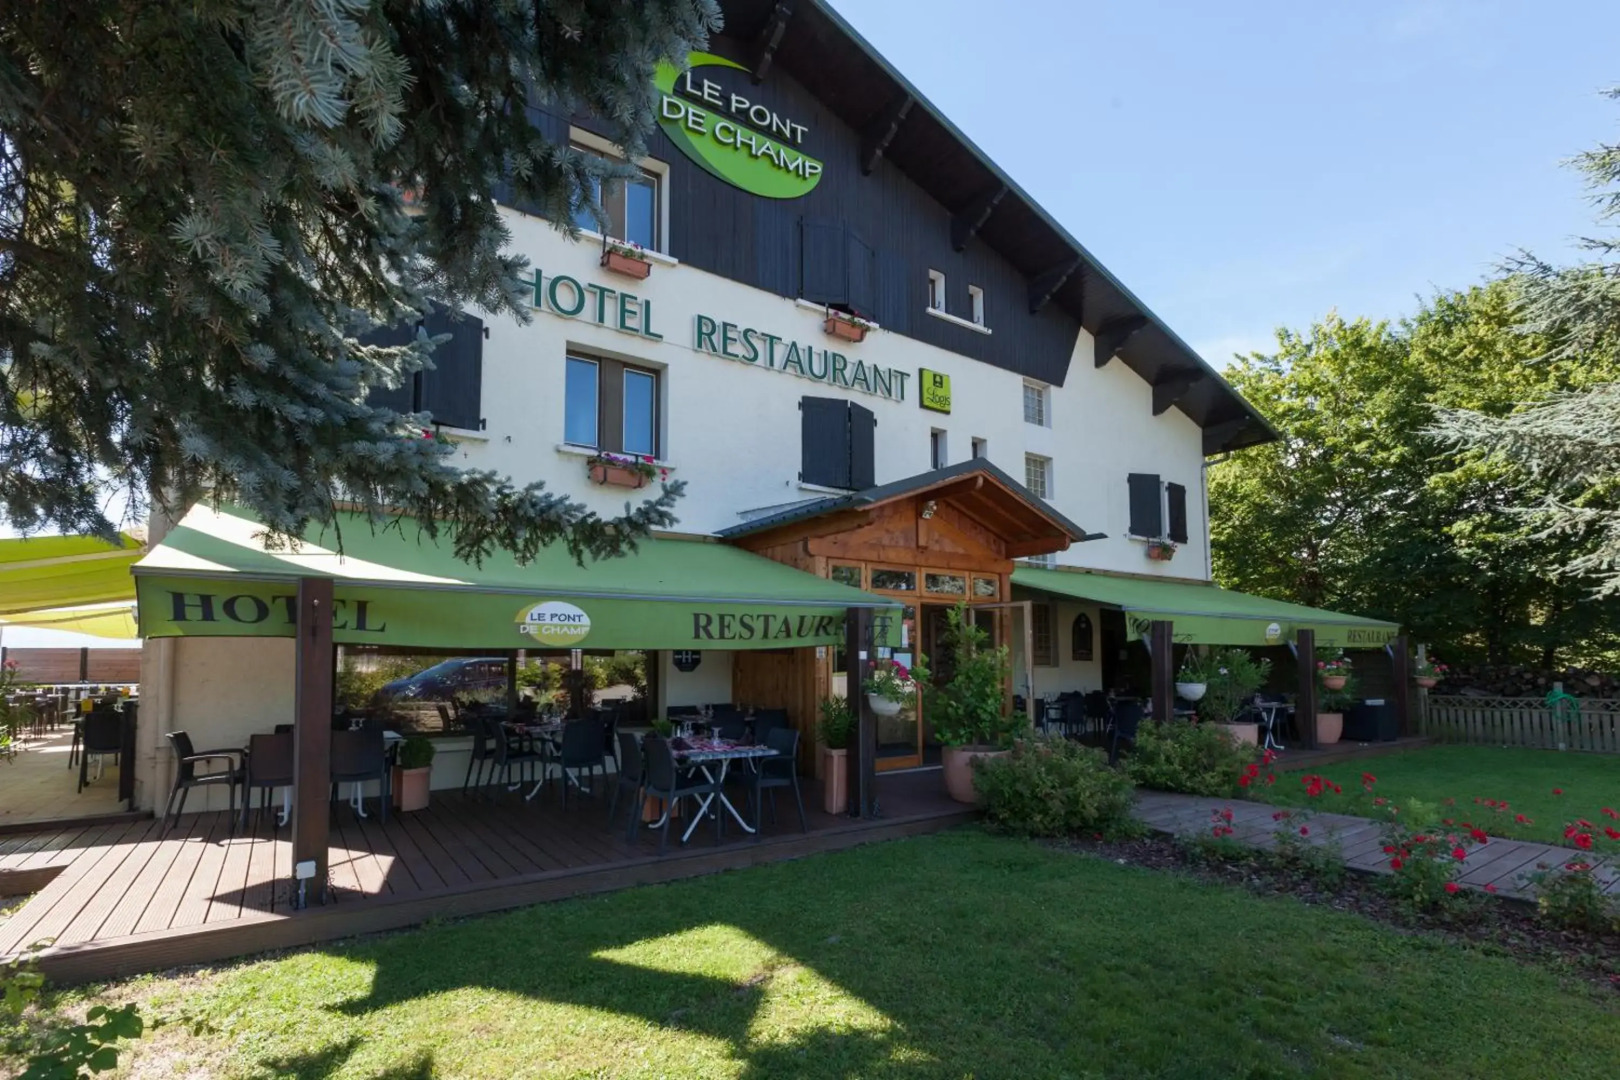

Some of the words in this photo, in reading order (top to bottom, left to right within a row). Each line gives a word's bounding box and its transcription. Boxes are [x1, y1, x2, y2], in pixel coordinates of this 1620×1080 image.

[662, 95, 707, 133] DE
[714, 121, 822, 178] CHAMP
[685, 71, 723, 106] LE
[730, 93, 809, 144] PONT
[693, 314, 911, 401] RESTAURANT
[519, 624, 539, 634] DE
[530, 612, 546, 622] LE
[550, 612, 584, 623] PONT
